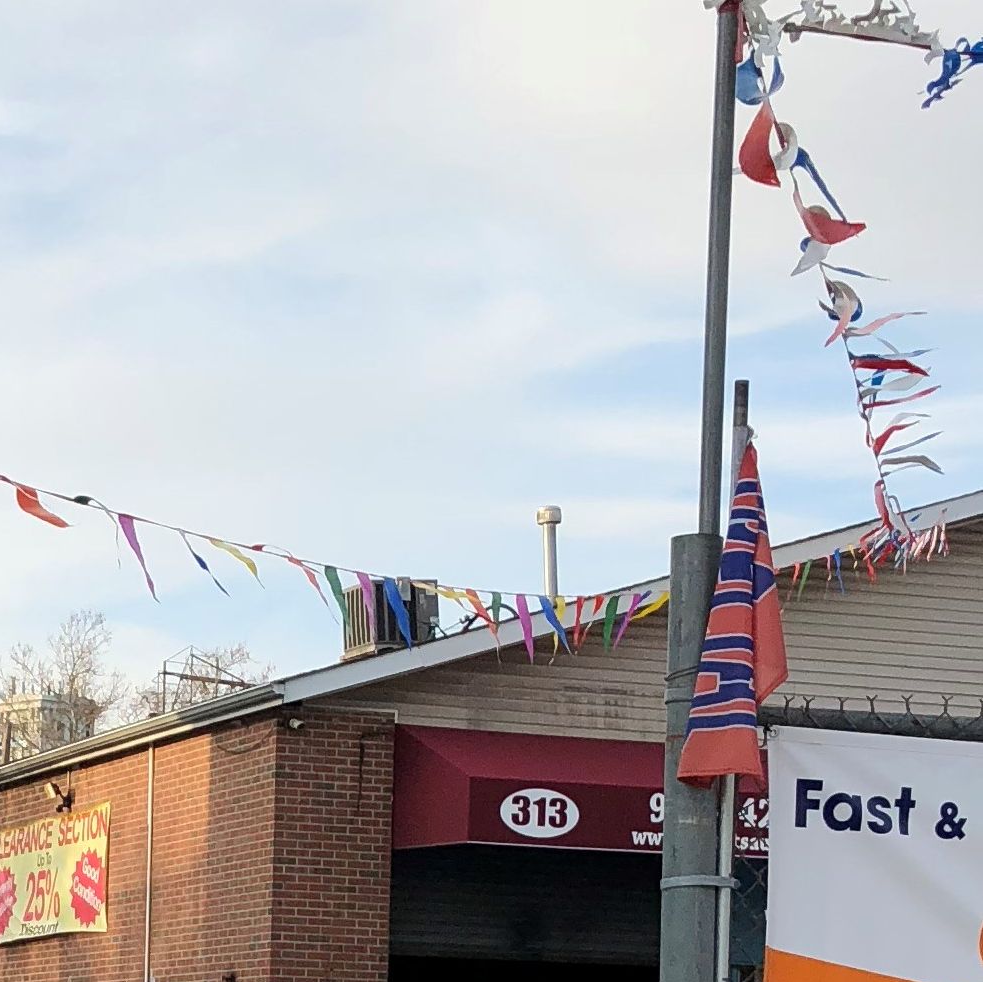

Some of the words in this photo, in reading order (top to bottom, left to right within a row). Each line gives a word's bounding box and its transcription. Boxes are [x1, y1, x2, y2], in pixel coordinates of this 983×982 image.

[58, 807, 108, 847] SECTION
[511, 795, 567, 828] 313
[795, 778, 916, 835] Fast
[935, 802, 967, 840] &
[82, 857, 100, 882] Good
[23, 867, 61, 922] 25%
[19, 921, 59, 936] Discount
